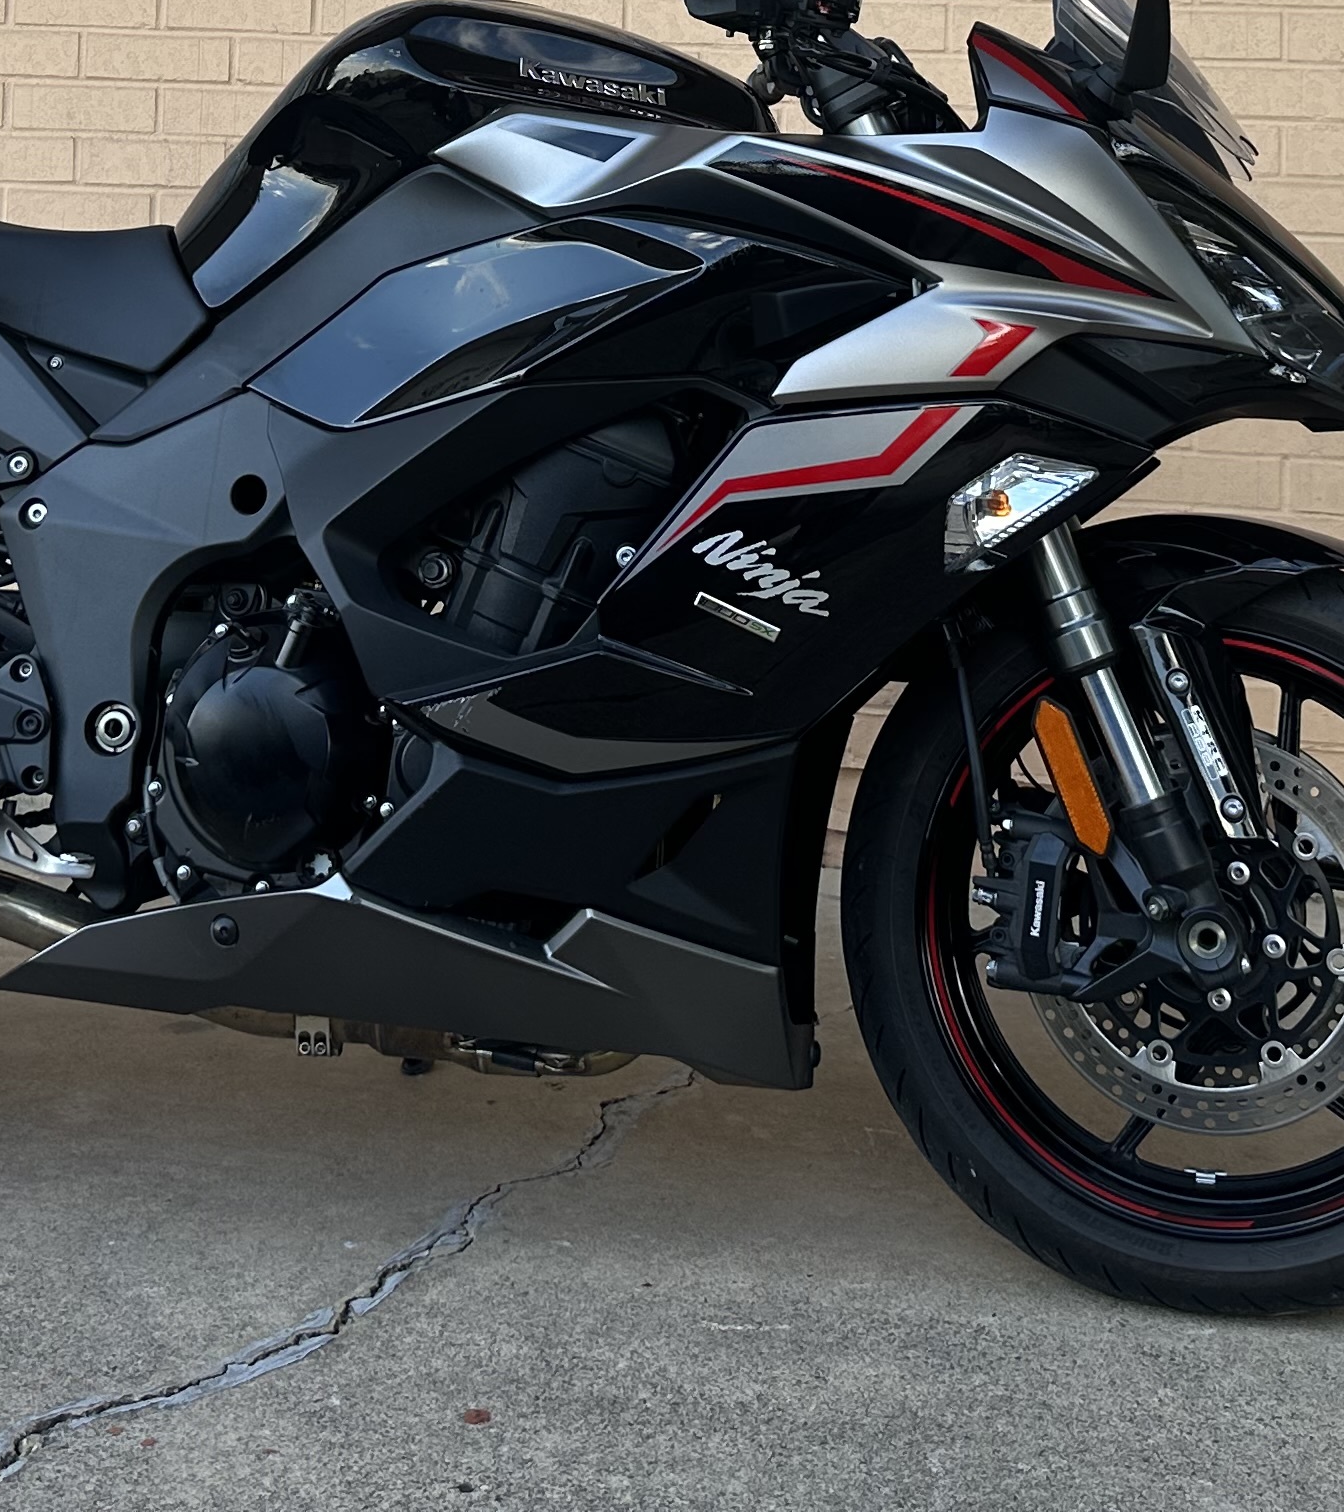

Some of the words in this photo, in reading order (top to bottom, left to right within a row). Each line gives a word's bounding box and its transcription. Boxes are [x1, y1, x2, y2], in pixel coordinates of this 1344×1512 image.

[519, 57, 667, 106] Kawasaki
[692, 530, 830, 618] Ninja
[1029, 880, 1046, 938] Kawasaki
